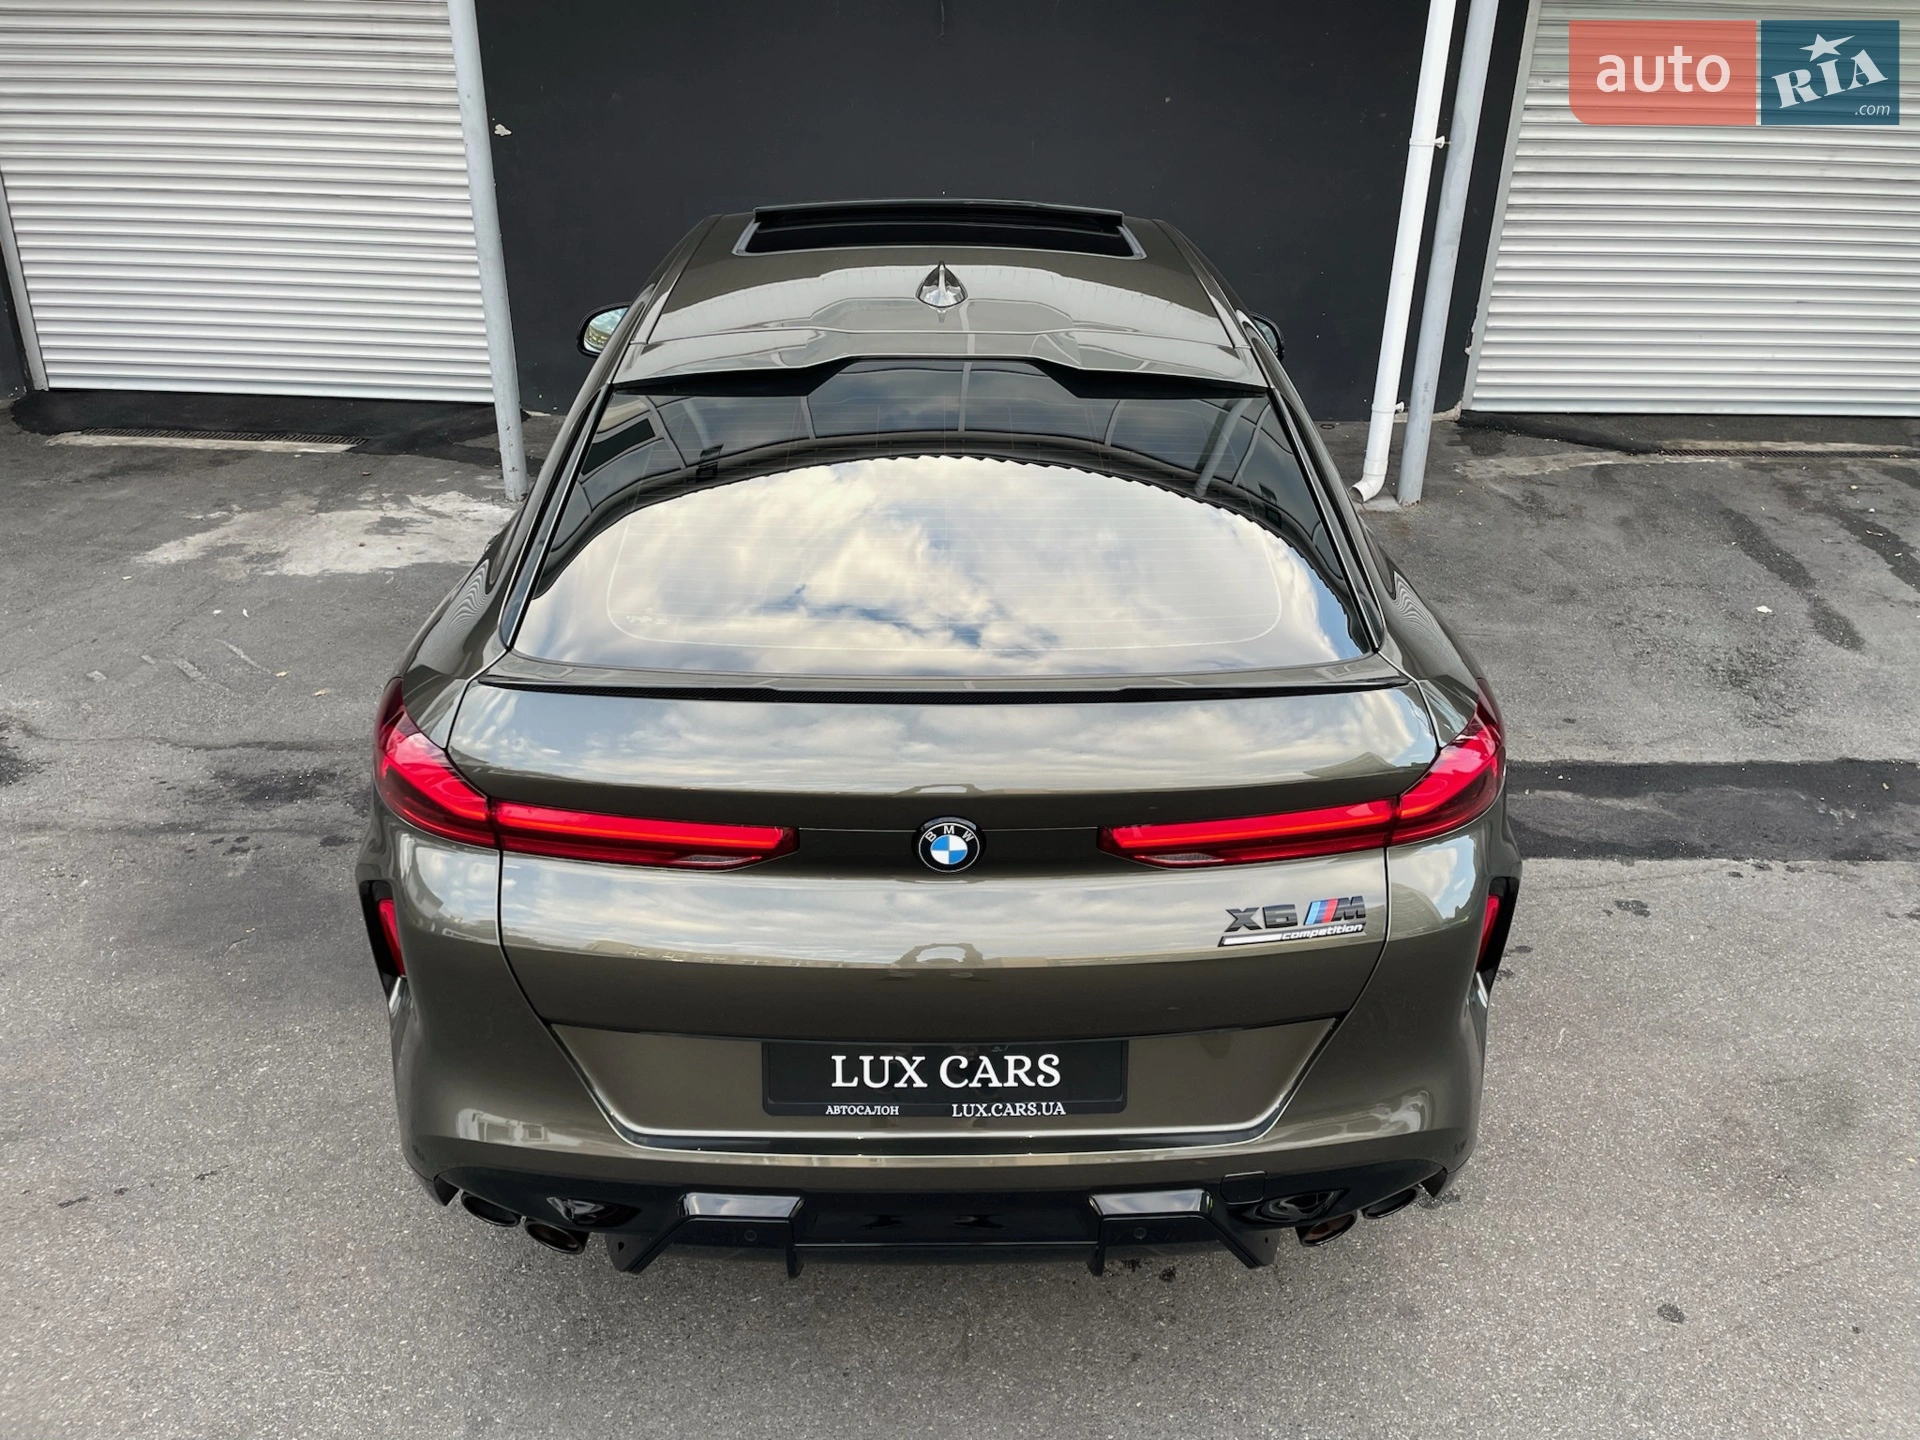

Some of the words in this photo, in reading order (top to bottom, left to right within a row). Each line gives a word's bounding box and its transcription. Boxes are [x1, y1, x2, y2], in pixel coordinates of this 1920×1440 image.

[925, 825, 975, 843] BMW
[1224, 904, 1298, 933] X6
[1282, 923, 1363, 940] competition
[831, 1055, 928, 1089] LUX
[939, 1053, 1062, 1089] CARS
[825, 1104, 900, 1116] АВТОСАЛОН
[951, 1101, 1067, 1118] LUX.CARS.UA
